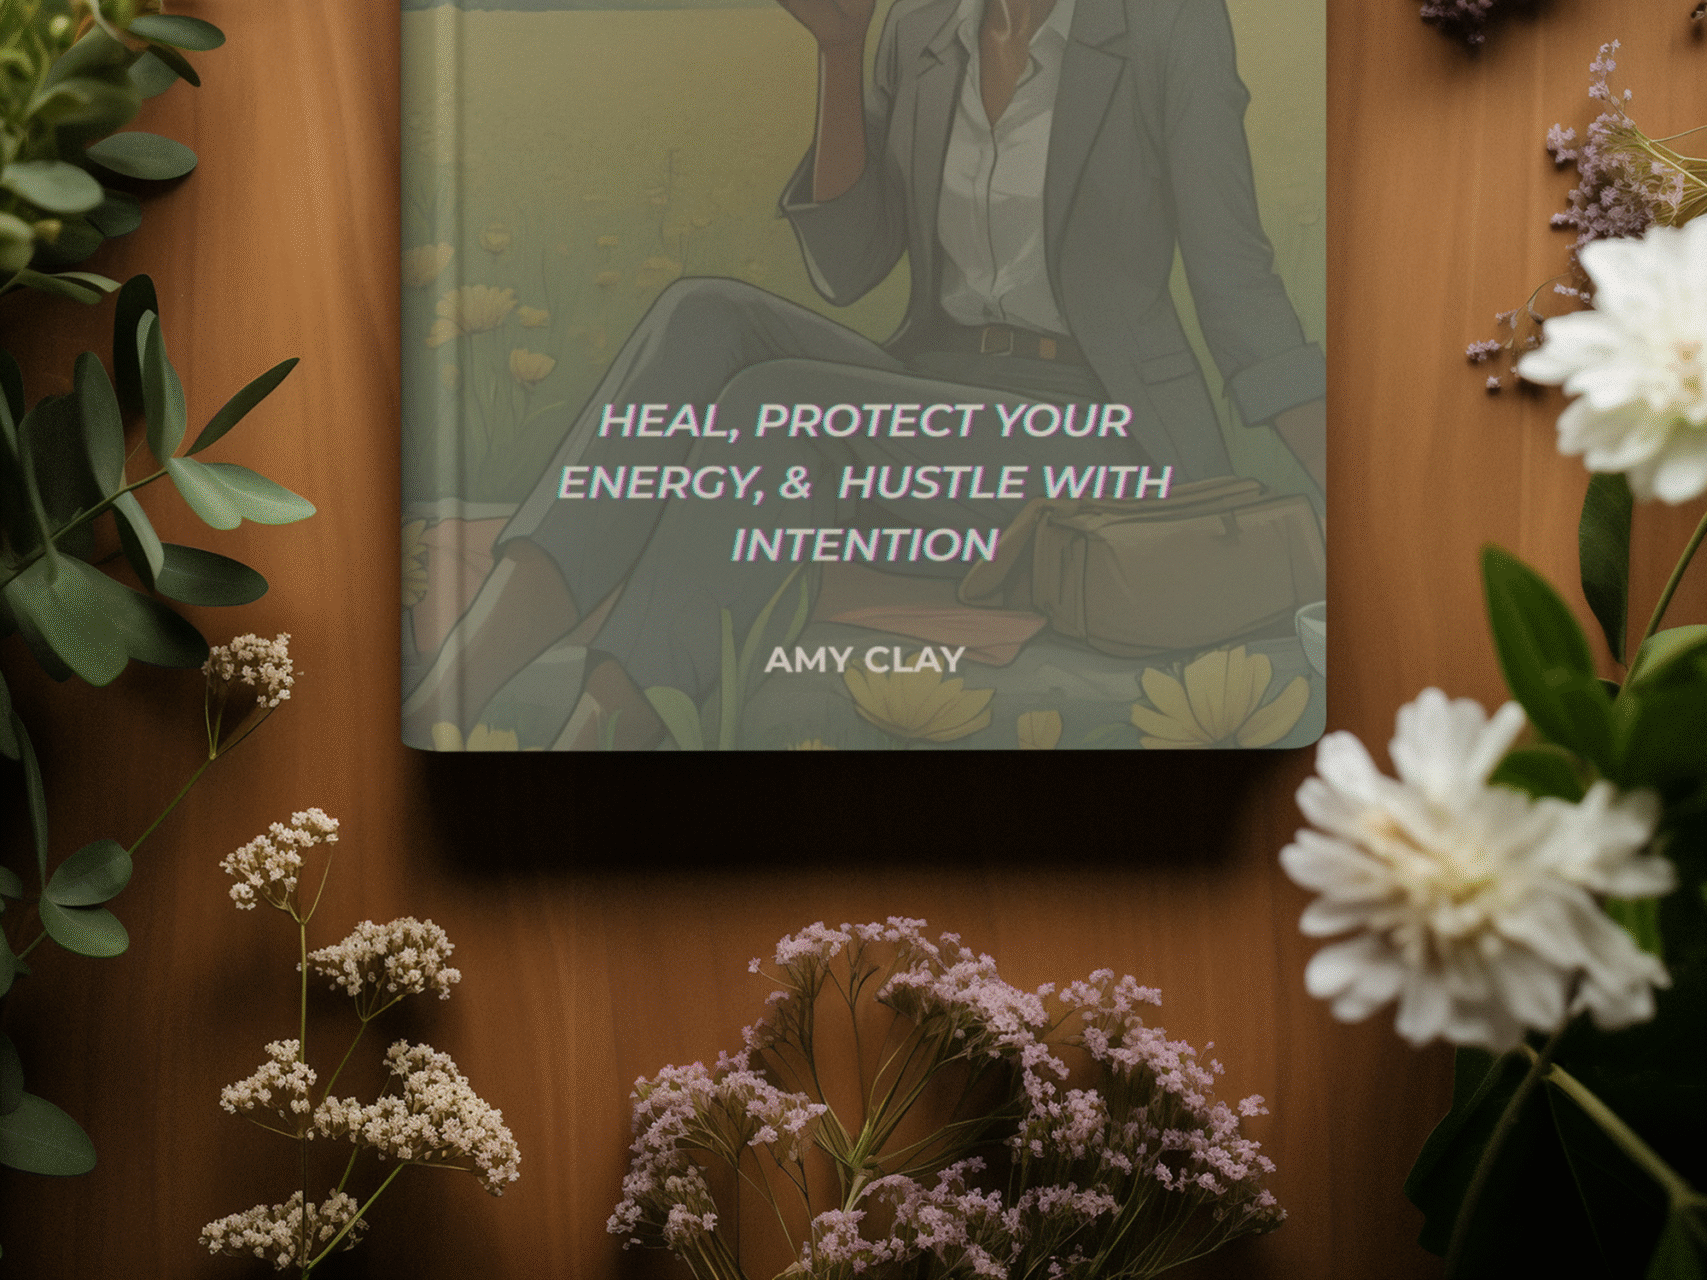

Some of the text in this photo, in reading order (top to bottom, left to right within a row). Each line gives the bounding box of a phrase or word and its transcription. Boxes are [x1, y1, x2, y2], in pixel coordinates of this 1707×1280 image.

[598, 403, 1133, 443] HEAL, PROTECT YOUR
[557, 465, 1173, 506] ENERGY, & HUSTLE WITH
[729, 528, 999, 562] INTENTION
[764, 646, 966, 673] AMY CLAY
